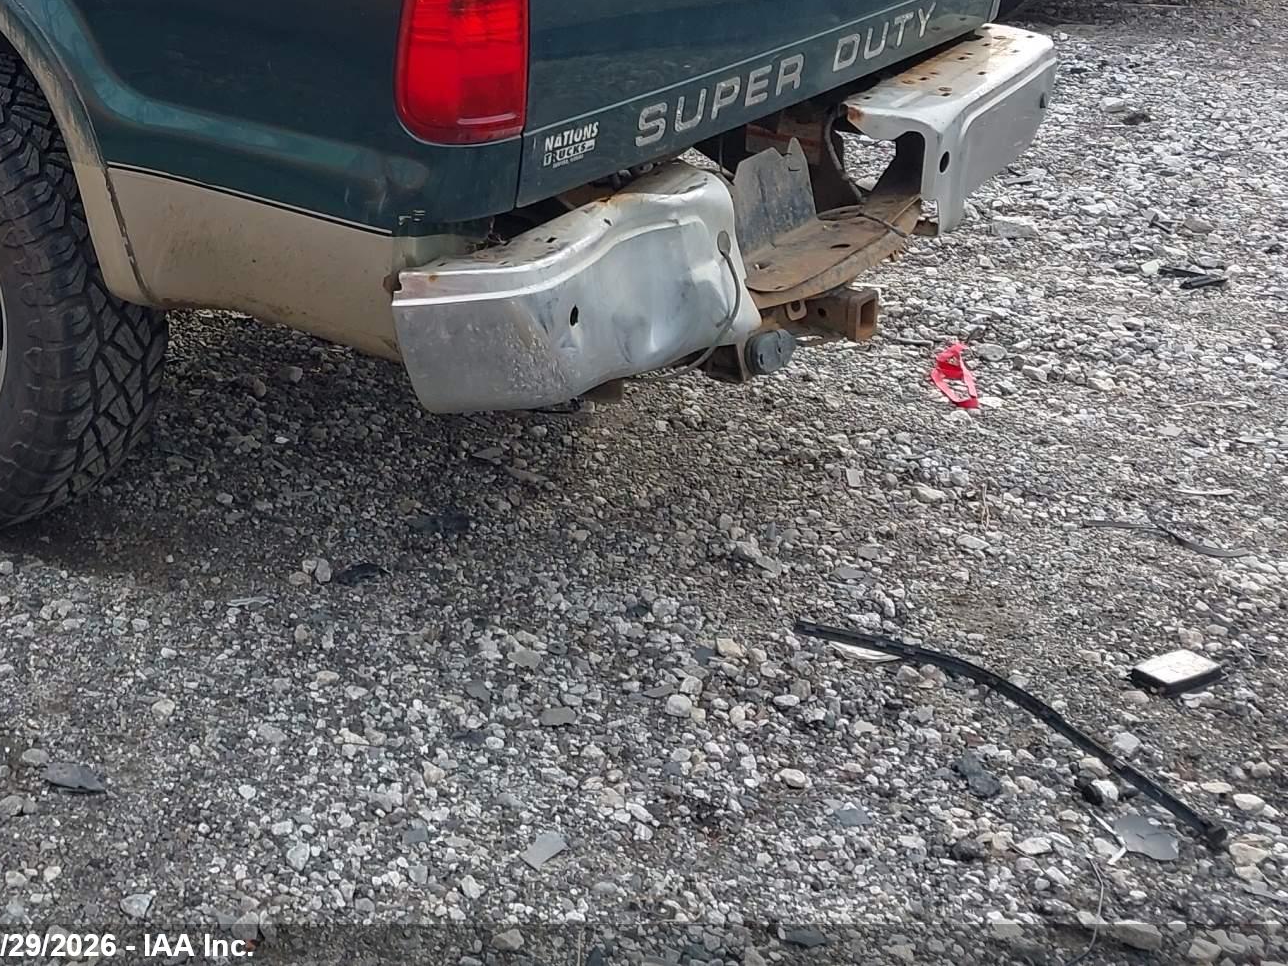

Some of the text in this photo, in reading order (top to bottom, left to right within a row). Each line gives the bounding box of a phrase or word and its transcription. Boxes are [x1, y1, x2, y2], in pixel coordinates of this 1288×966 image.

[634, 1, 937, 148] SUPER DUTY
[544, 121, 600, 152] NATIONS
